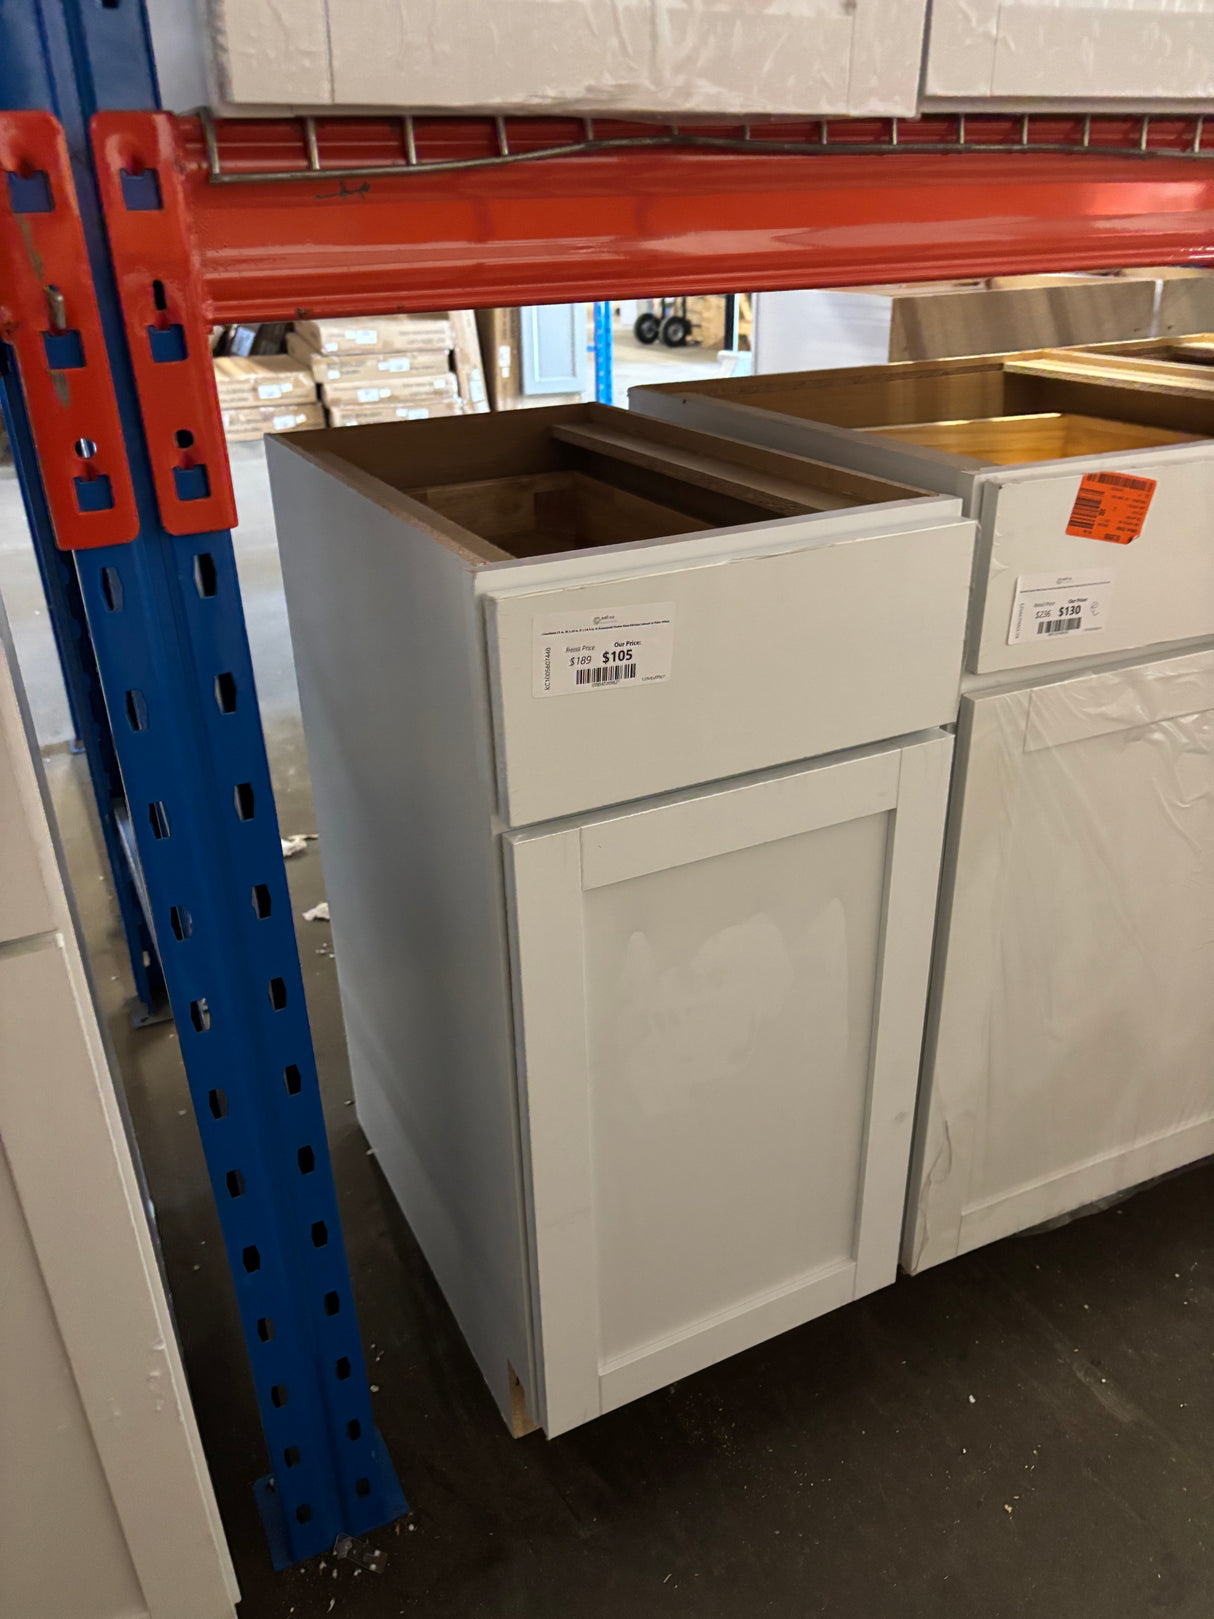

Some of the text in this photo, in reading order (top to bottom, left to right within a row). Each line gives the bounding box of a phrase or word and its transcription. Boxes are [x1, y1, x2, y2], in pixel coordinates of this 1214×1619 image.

[1058, 605, 1082, 617] $130
[569, 655, 592, 667] $189
[602, 649, 633, 665] $105
